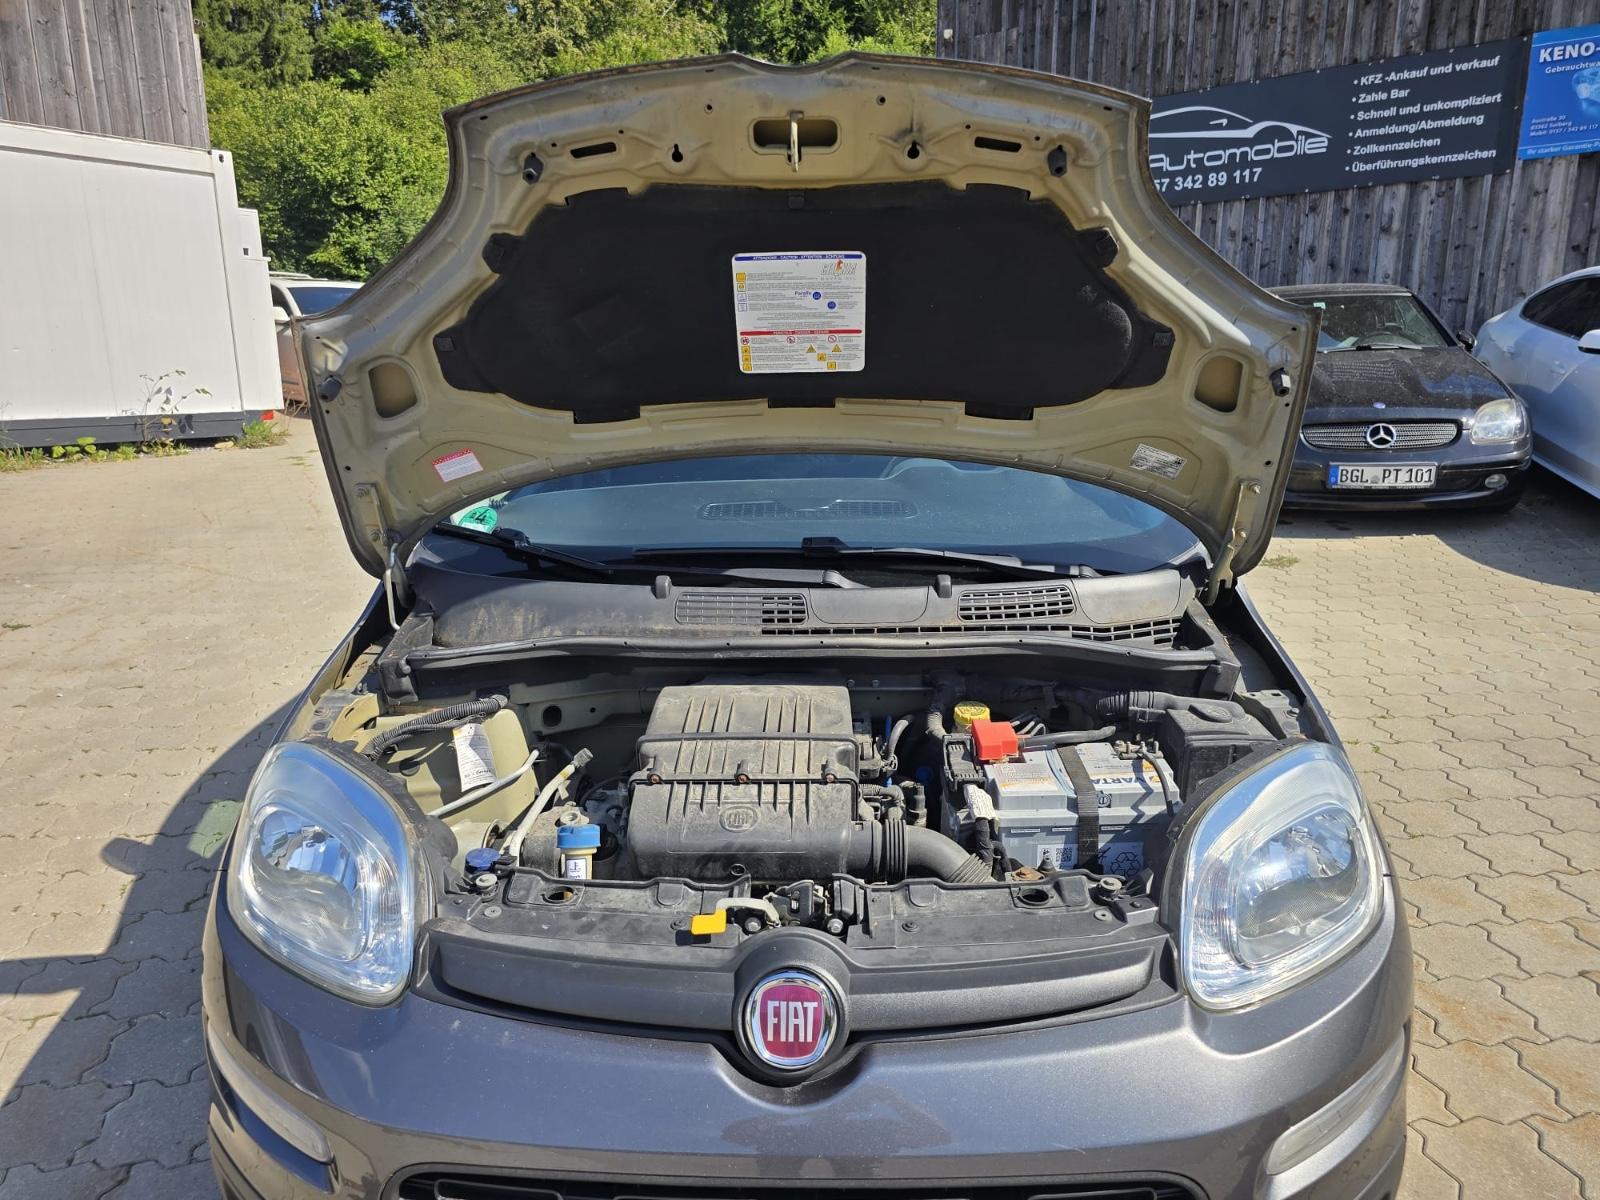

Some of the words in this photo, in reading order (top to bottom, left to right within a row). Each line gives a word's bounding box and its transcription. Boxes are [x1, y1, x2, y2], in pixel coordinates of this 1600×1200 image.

[1539, 41, 1600, 63] KENO-
[1360, 73, 1383, 86] KFZ
[1430, 63, 1452, 76] und
[1455, 55, 1501, 72] verkauf
[1356, 107, 1396, 121] Schnell
[1399, 104, 1421, 115] und
[1423, 92, 1502, 113] unkompliziert
[1358, 91, 1387, 104] Zahle
[1390, 88, 1410, 99] Bar
[1354, 114, 1485, 139] Anmeldung/Abmeldung
[1353, 137, 1441, 155] Zollkennzeichen
[1352, 149, 1496, 173] Überführungskennzeichen
[1174, 174, 1203, 191] 342
[1207, 171, 1227, 187] 89
[1233, 167, 1263, 184] 117
[1340, 468, 1369, 483] BGL
[1382, 468, 1402, 483] PT
[1405, 468, 1433, 483] 101
[767, 1000, 819, 1042] FIAT
